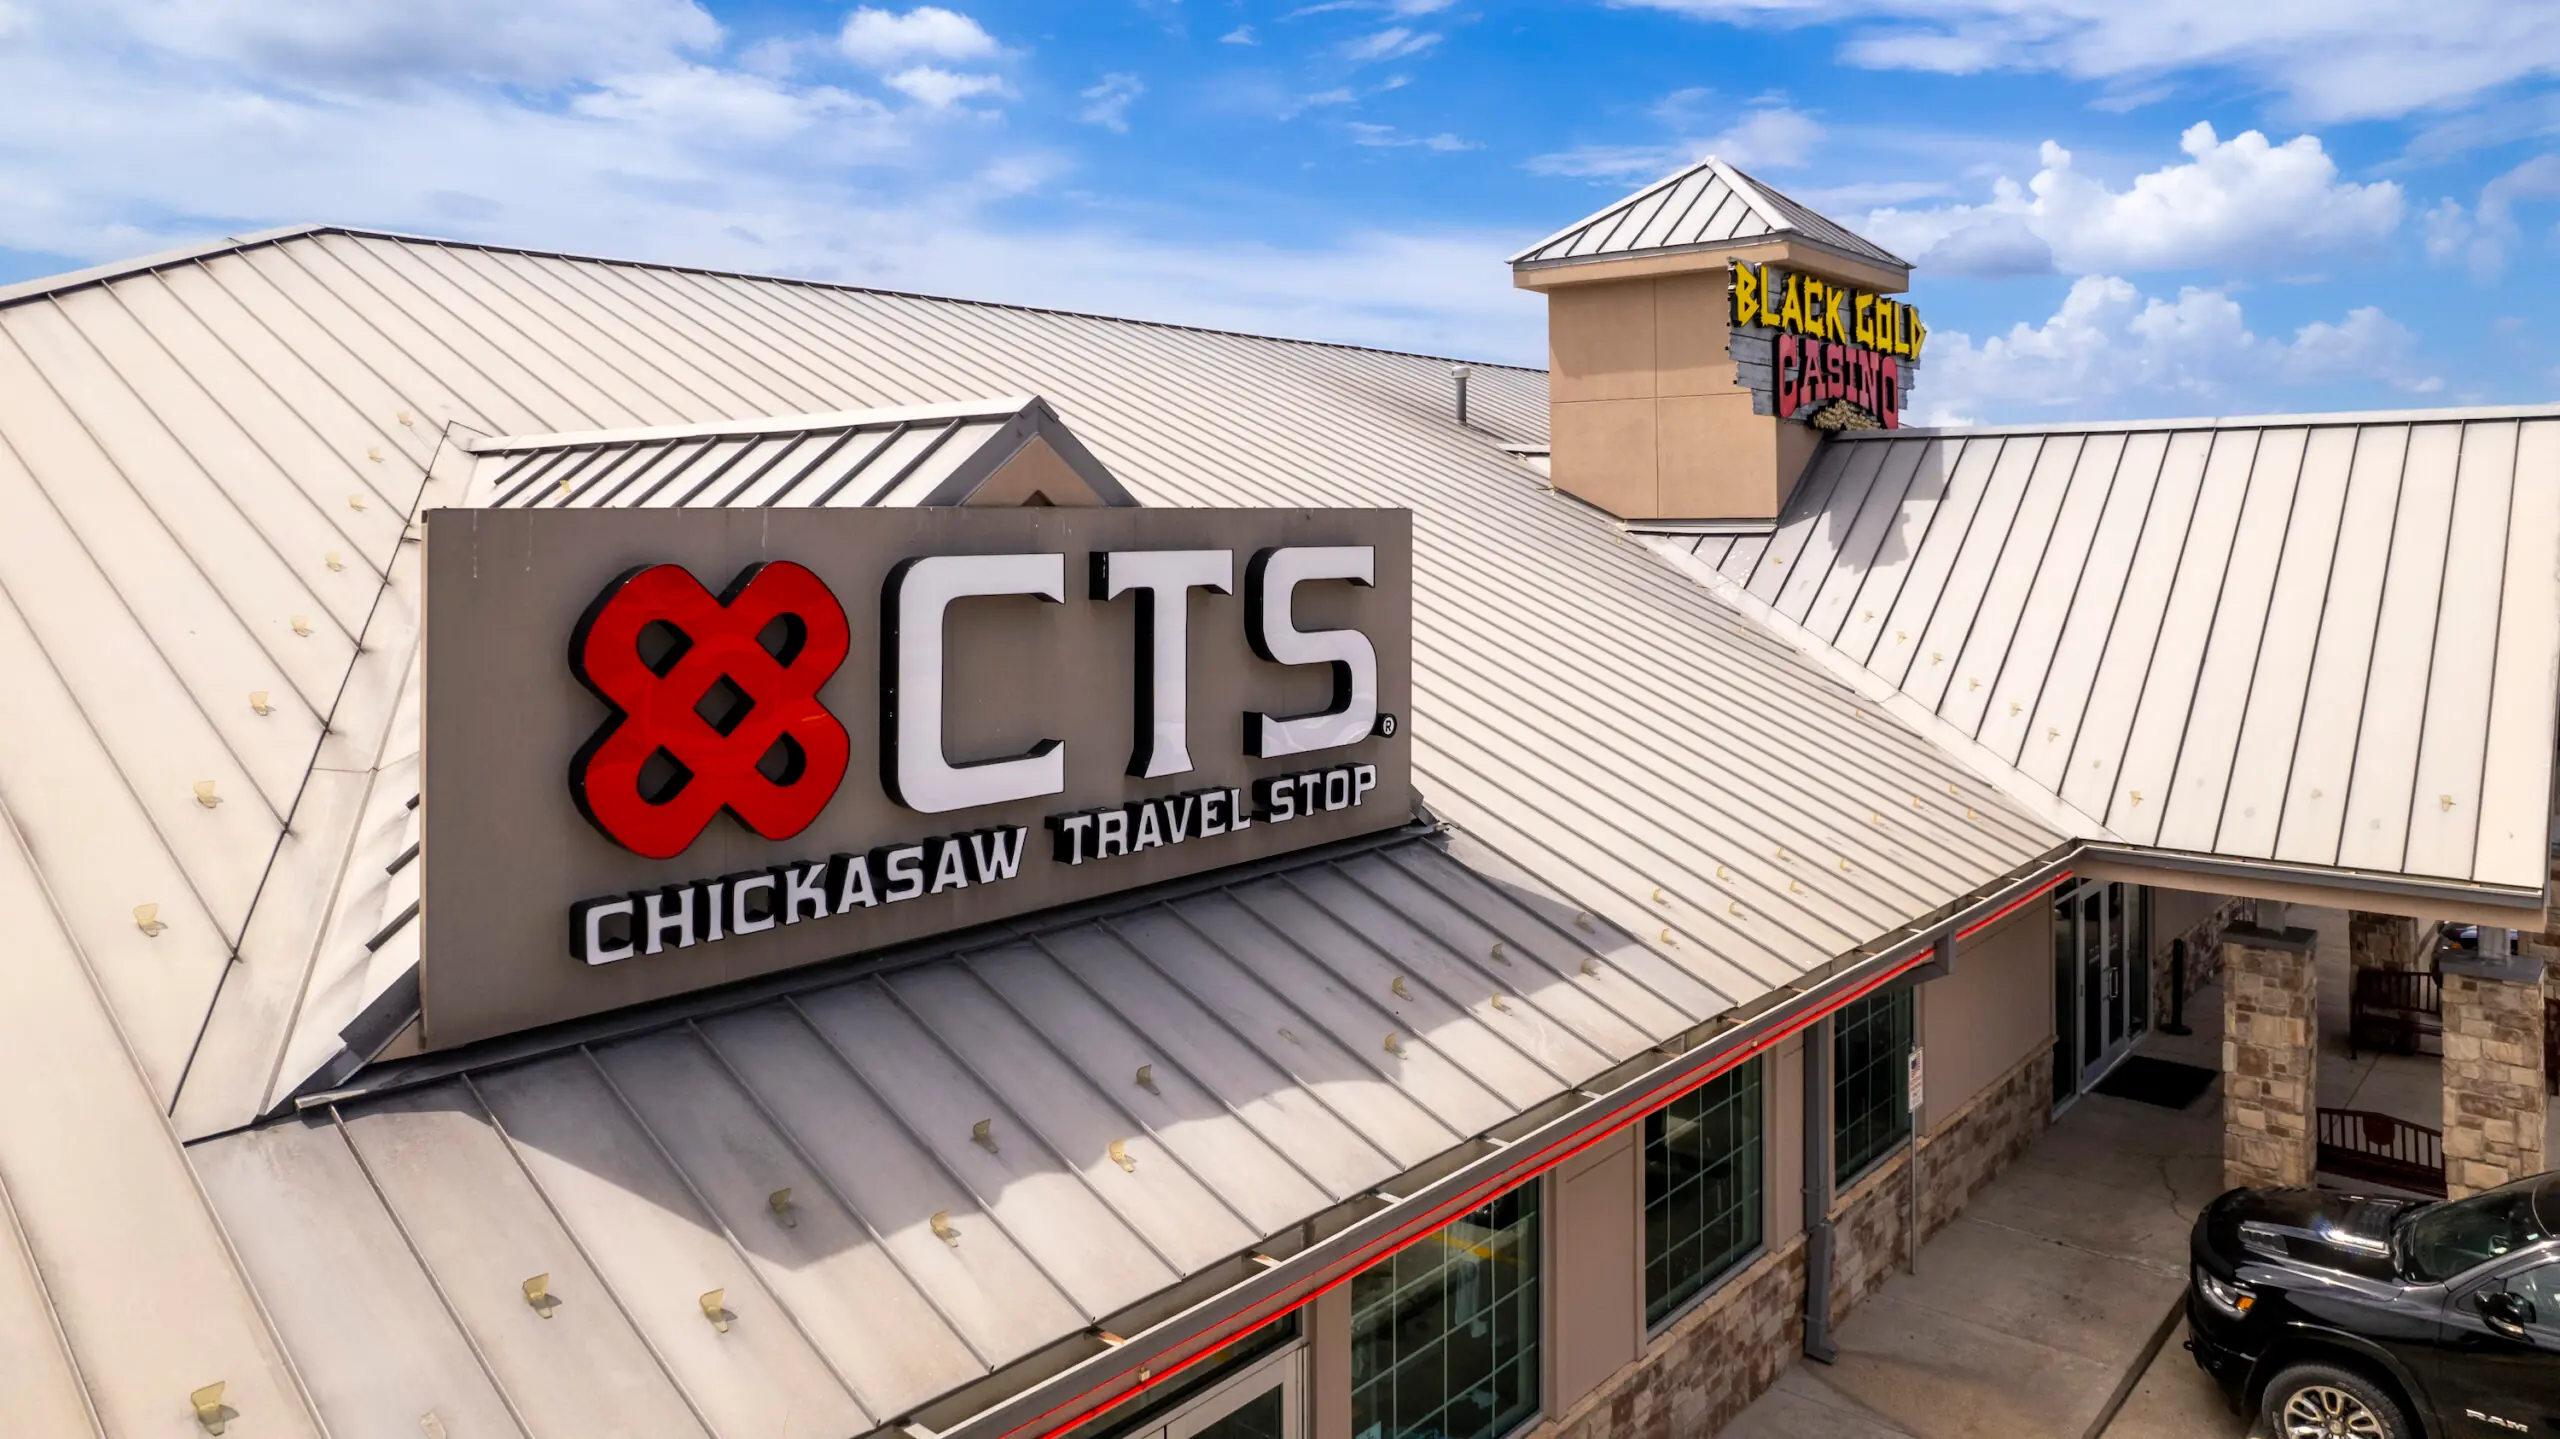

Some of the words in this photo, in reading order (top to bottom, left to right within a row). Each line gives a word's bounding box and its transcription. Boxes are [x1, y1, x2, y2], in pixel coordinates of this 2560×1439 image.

[1735, 261, 1846, 344] BLACK
[1855, 293, 1927, 360] GOLD
[1778, 333, 1898, 429] CASINO
[883, 546, 1376, 813] CTS
[584, 826, 1028, 966] CHICKASAW
[1060, 788, 1251, 865] TRAVEL
[1270, 764, 1378, 824] STOP
[2465, 1408, 2528, 1433] RAM
